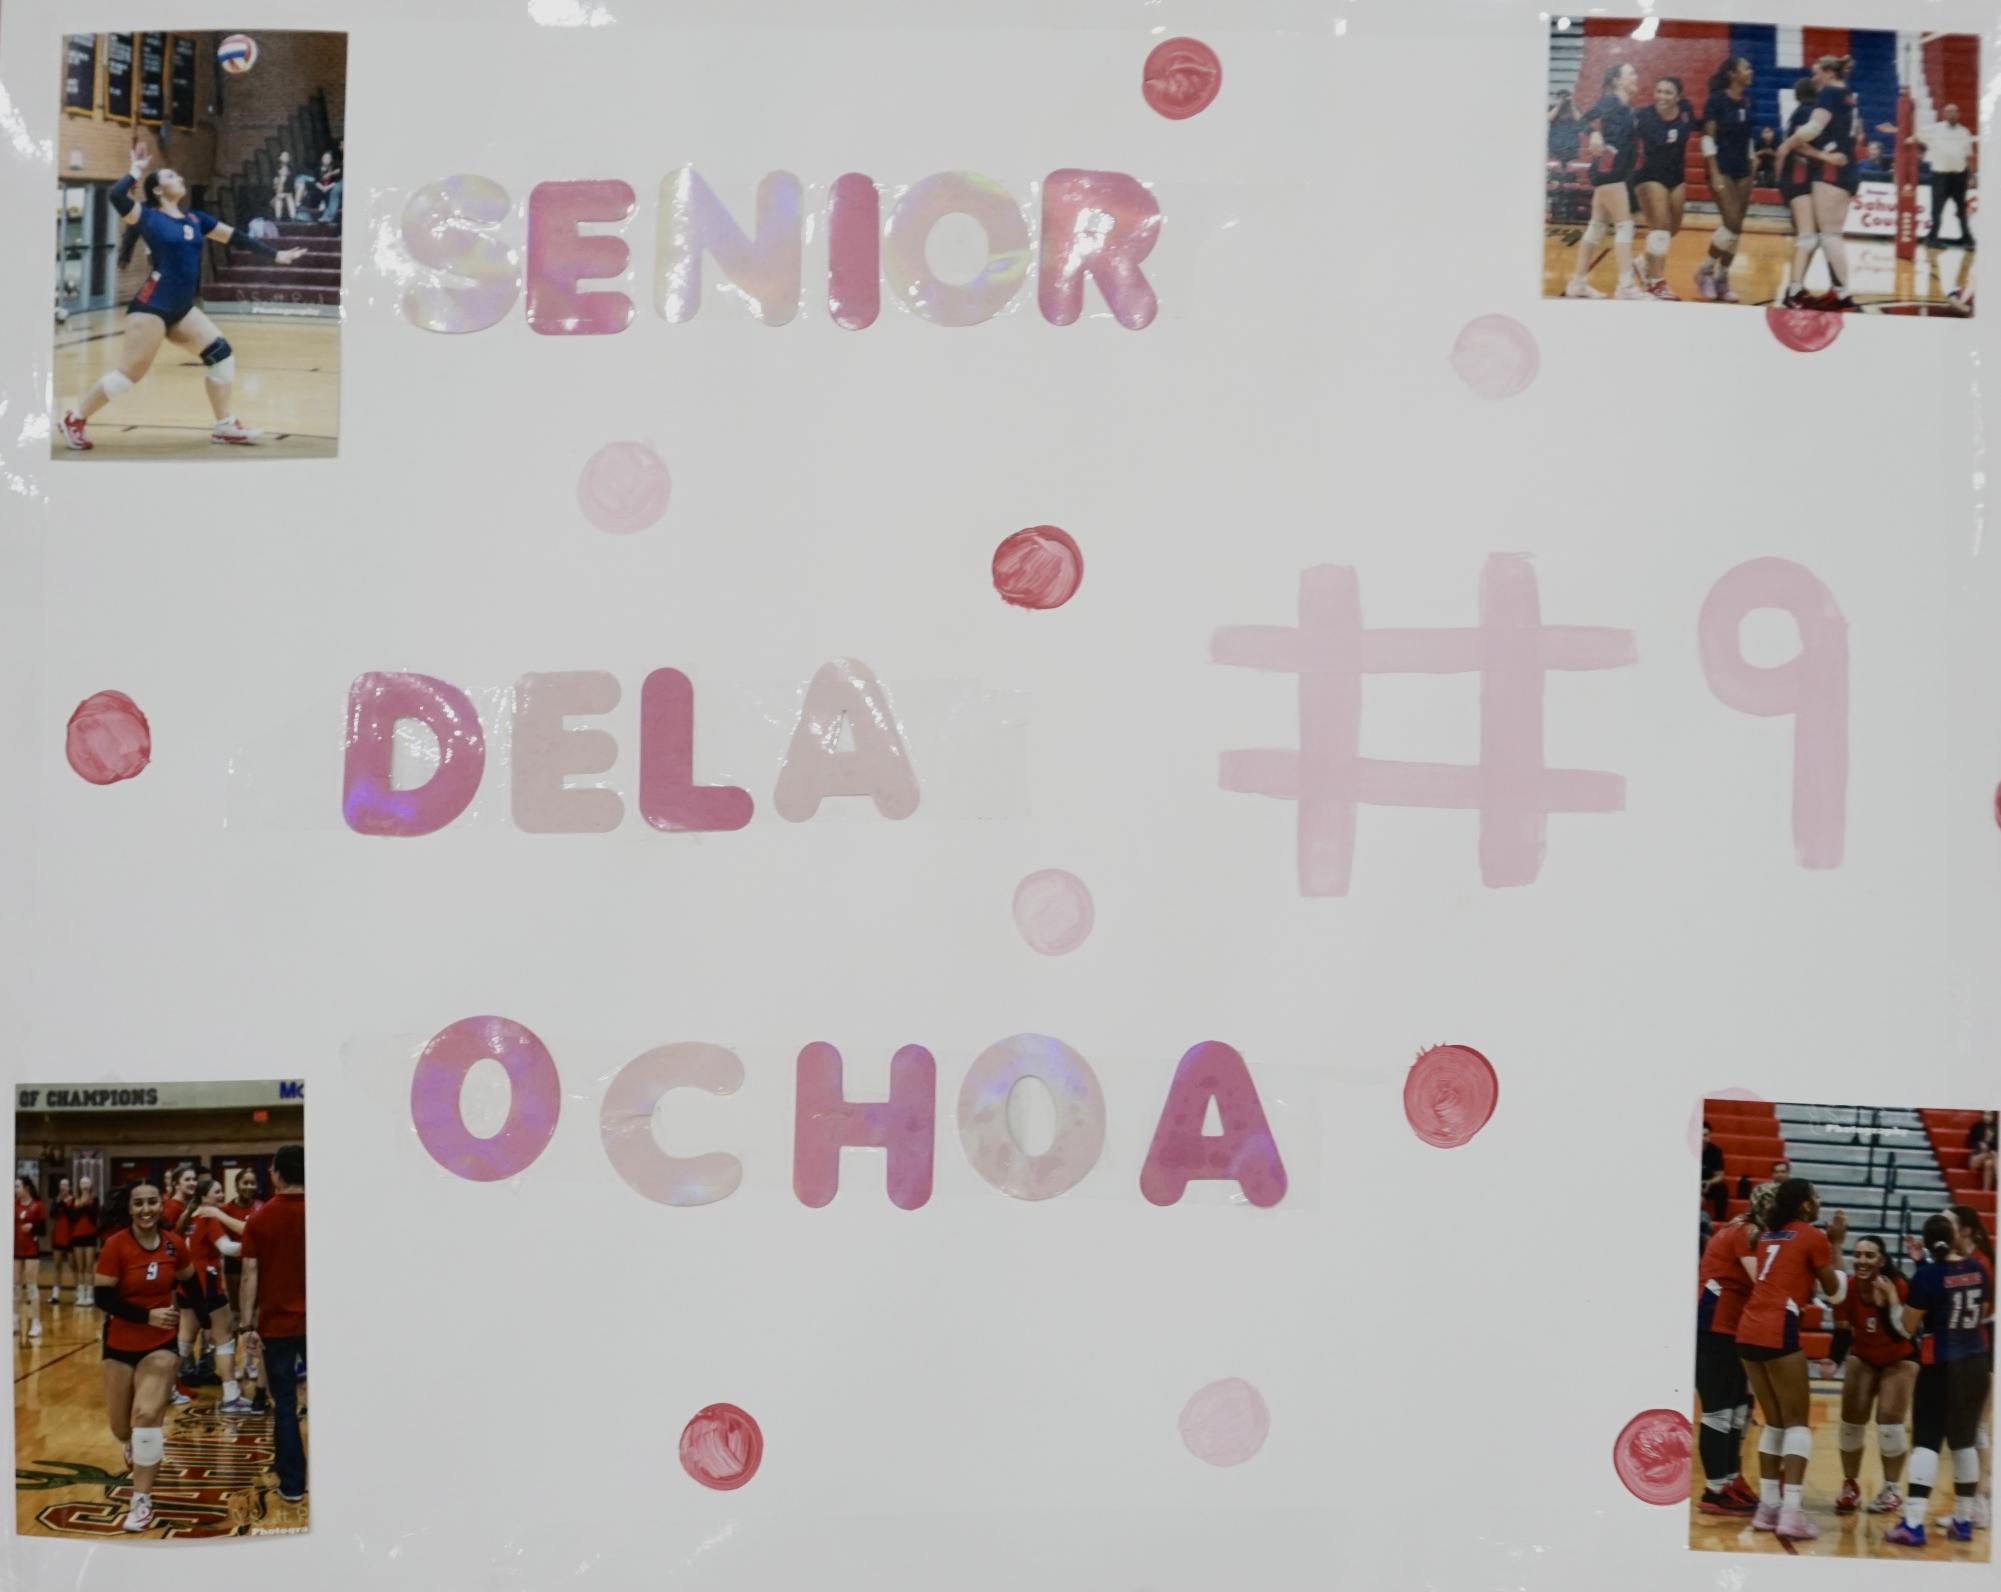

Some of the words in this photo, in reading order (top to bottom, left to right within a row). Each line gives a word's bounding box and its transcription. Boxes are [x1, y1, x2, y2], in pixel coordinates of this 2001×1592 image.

[401, 167, 1161, 336] SENIOR
[342, 656, 921, 838] DELA
[1209, 552, 1850, 898] #9
[19, 1090, 40, 1108] OF
[46, 1088, 159, 1107] CHAMPIONS
[410, 1015, 1289, 1212] OCHOA
[146, 1261, 159, 1280] 9
[1948, 1288, 1982, 1329] 15
